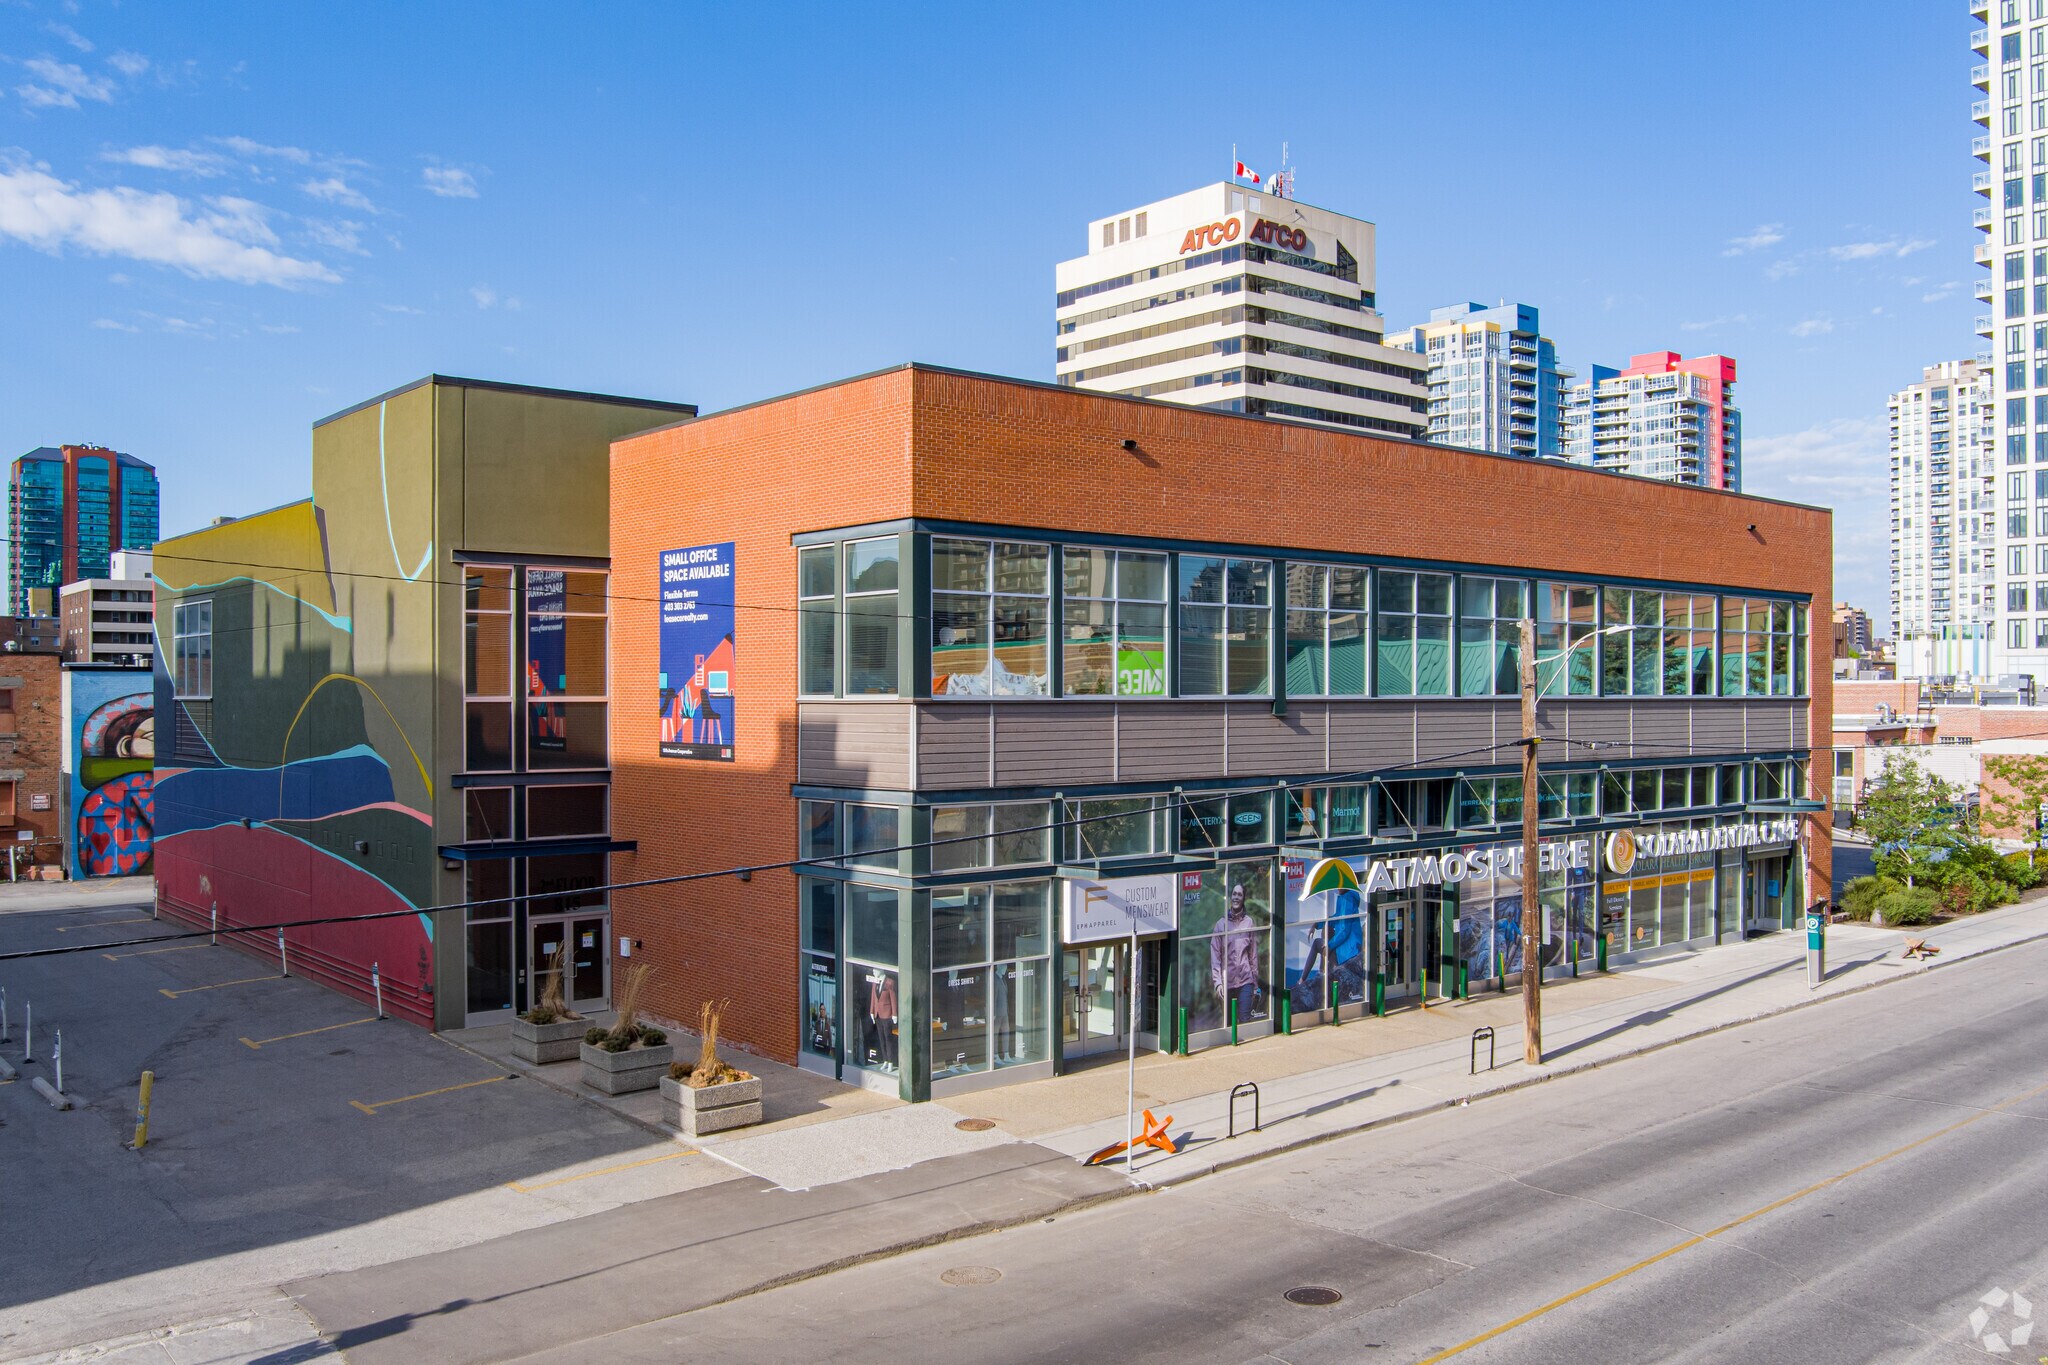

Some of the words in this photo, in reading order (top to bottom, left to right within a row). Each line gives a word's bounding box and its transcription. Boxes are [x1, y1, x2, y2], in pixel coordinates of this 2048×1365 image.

[1179, 217, 1240, 254] ATCO
[1250, 218, 1306, 251] ATCO
[664, 552, 688, 566] SMALL
[690, 548, 717, 563] OFFICE
[664, 568, 688, 582] SPACE
[689, 563, 730, 580] AVAILABLE
[664, 590, 682, 599] Flexible
[683, 588, 698, 597] Terms
[1237, 814, 1261, 823] KEEN
[1333, 806, 1360, 816] Marmot
[1367, 839, 1589, 893] ATMOSPHERE
[1125, 886, 1157, 903] CUSTOM
[1184, 892, 1200, 902] ALIVE
[1125, 902, 1169, 920] MENSWEAR
